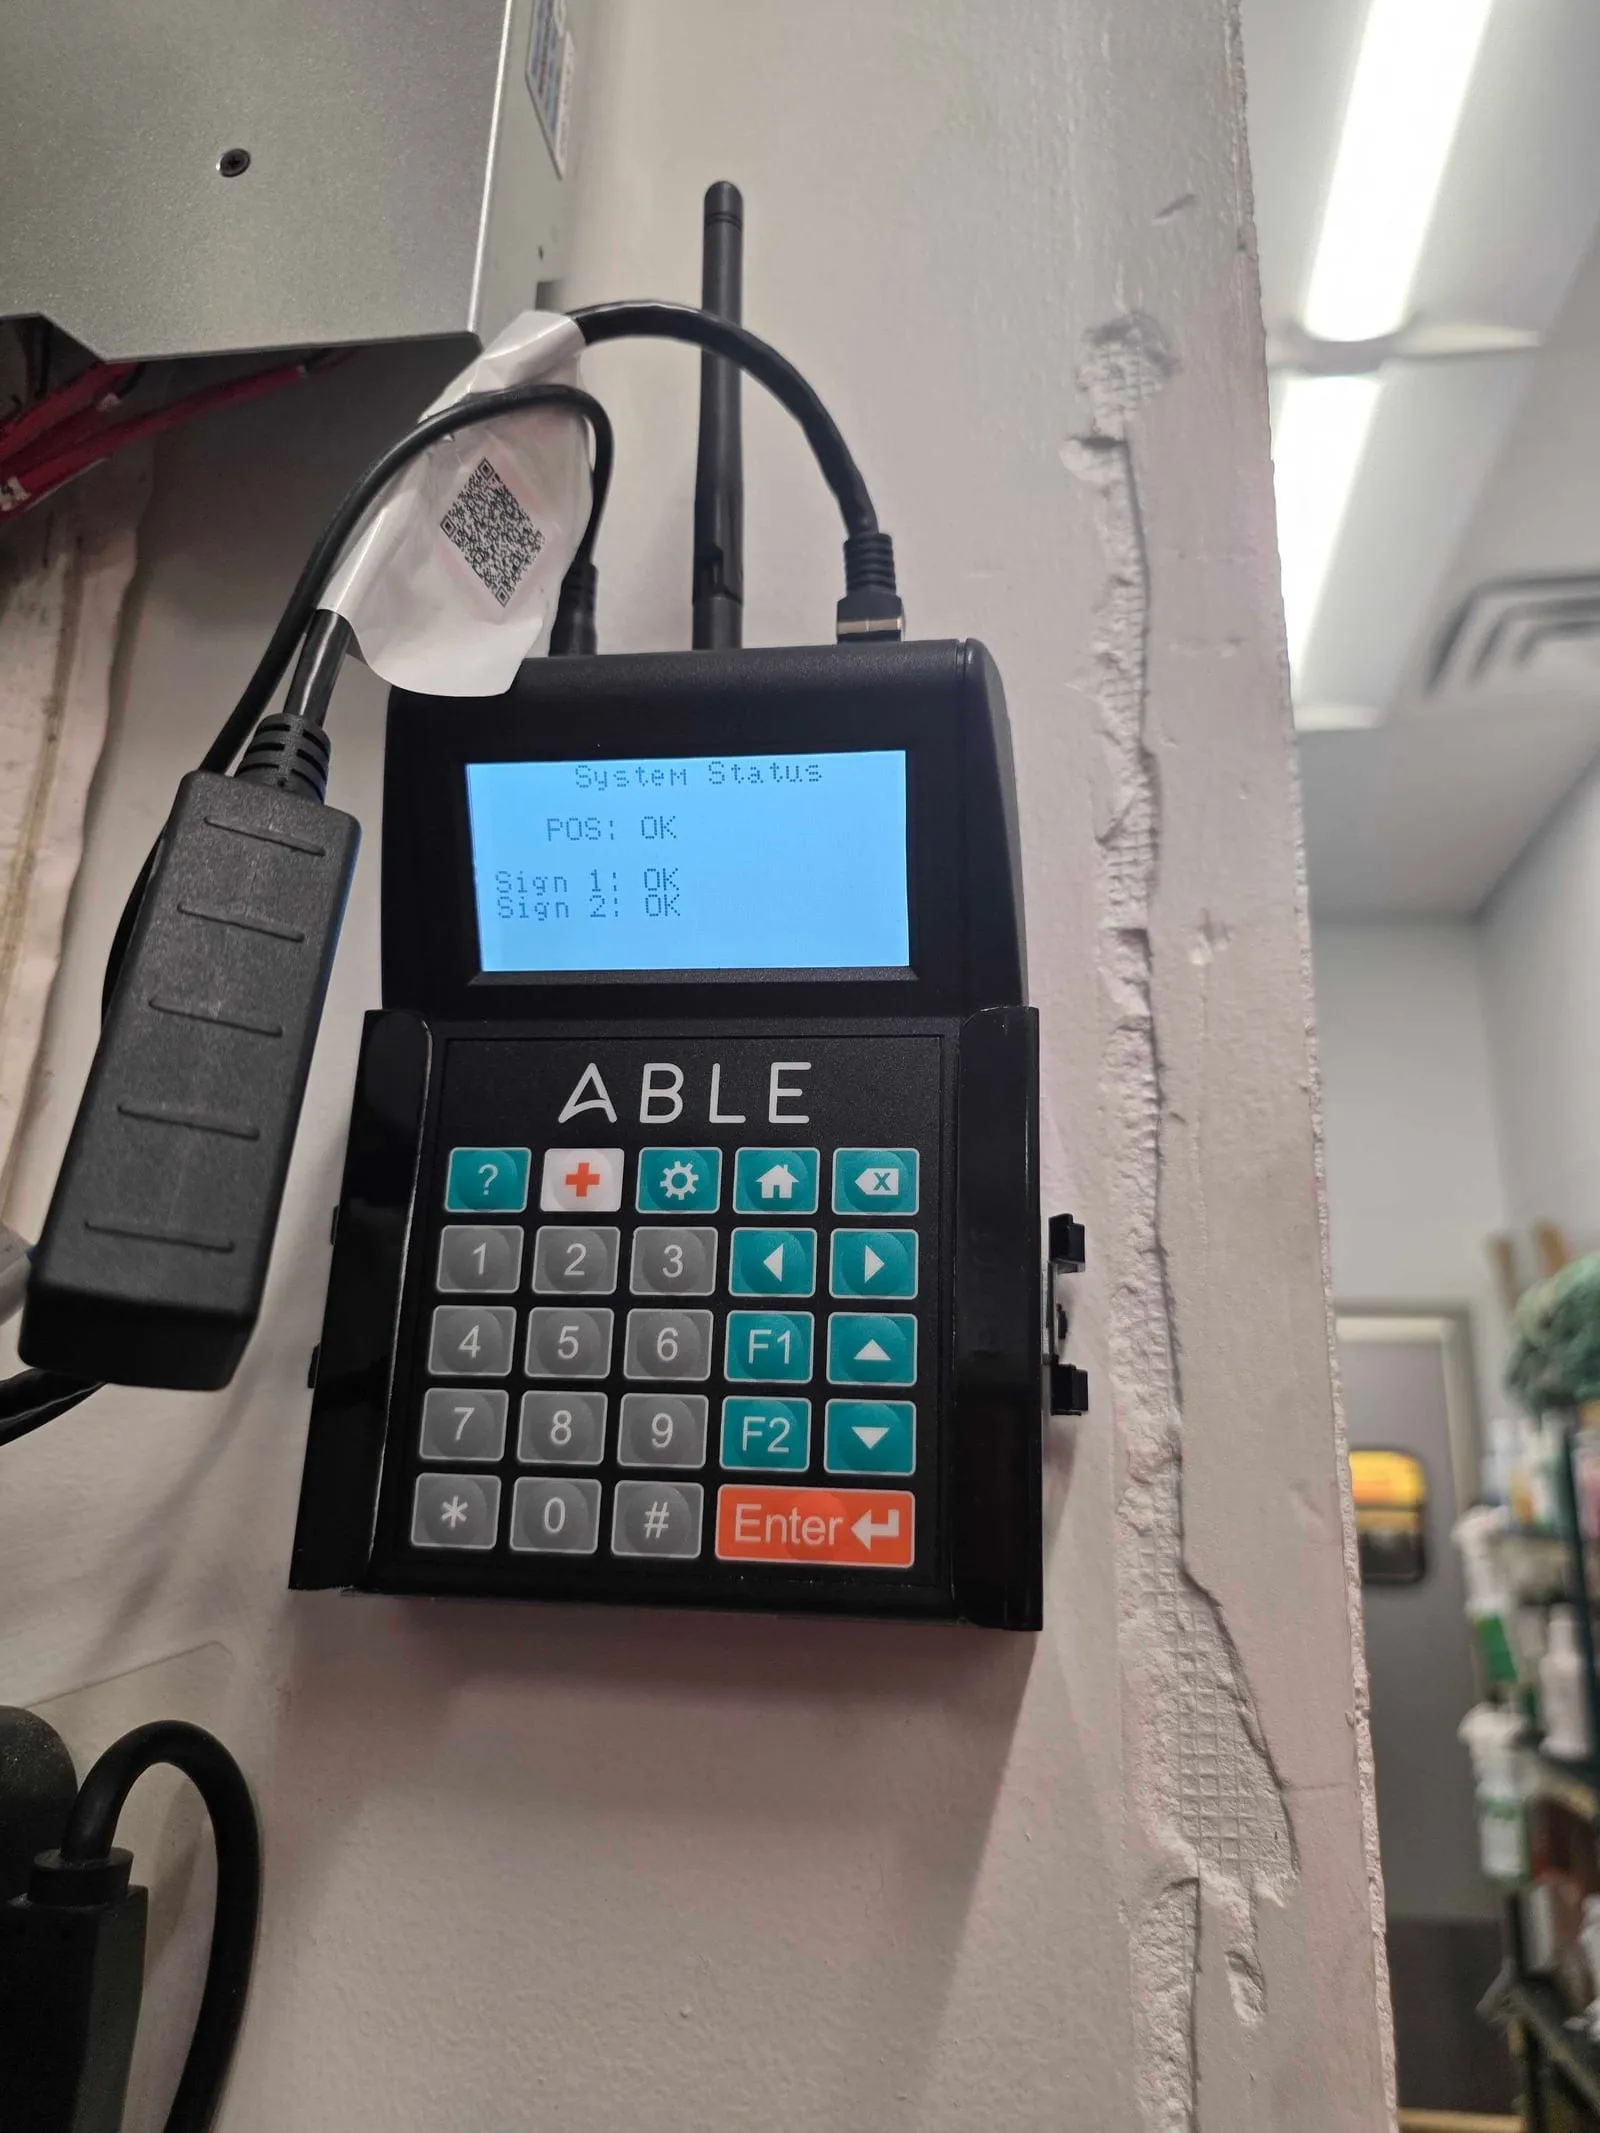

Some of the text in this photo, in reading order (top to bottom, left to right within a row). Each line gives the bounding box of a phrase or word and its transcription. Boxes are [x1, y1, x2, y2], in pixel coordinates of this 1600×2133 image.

[575, 760, 822, 791] System Status
[547, 815, 677, 841] POS: OK
[495, 867, 680, 896] Sign 1: OK
[497, 893, 681, 921] Sign 2: OK
[557, 1061, 812, 1124] ABLE
[478, 1163, 499, 1196] ?
[472, 1241, 487, 1275] 1
[564, 1242, 587, 1276] 2
[662, 1244, 684, 1278] 3
[458, 1324, 481, 1358] 4
[557, 1325, 580, 1360] 5
[656, 1326, 679, 1362] 6
[748, 1328, 791, 1365] F1
[453, 1406, 476, 1441] 7
[550, 1409, 573, 1445] 8
[651, 1412, 674, 1448] 9
[742, 1415, 791, 1453] F2
[543, 1496, 566, 1534] 0
[643, 1500, 670, 1539] #
[734, 1503, 844, 1546] Enter
